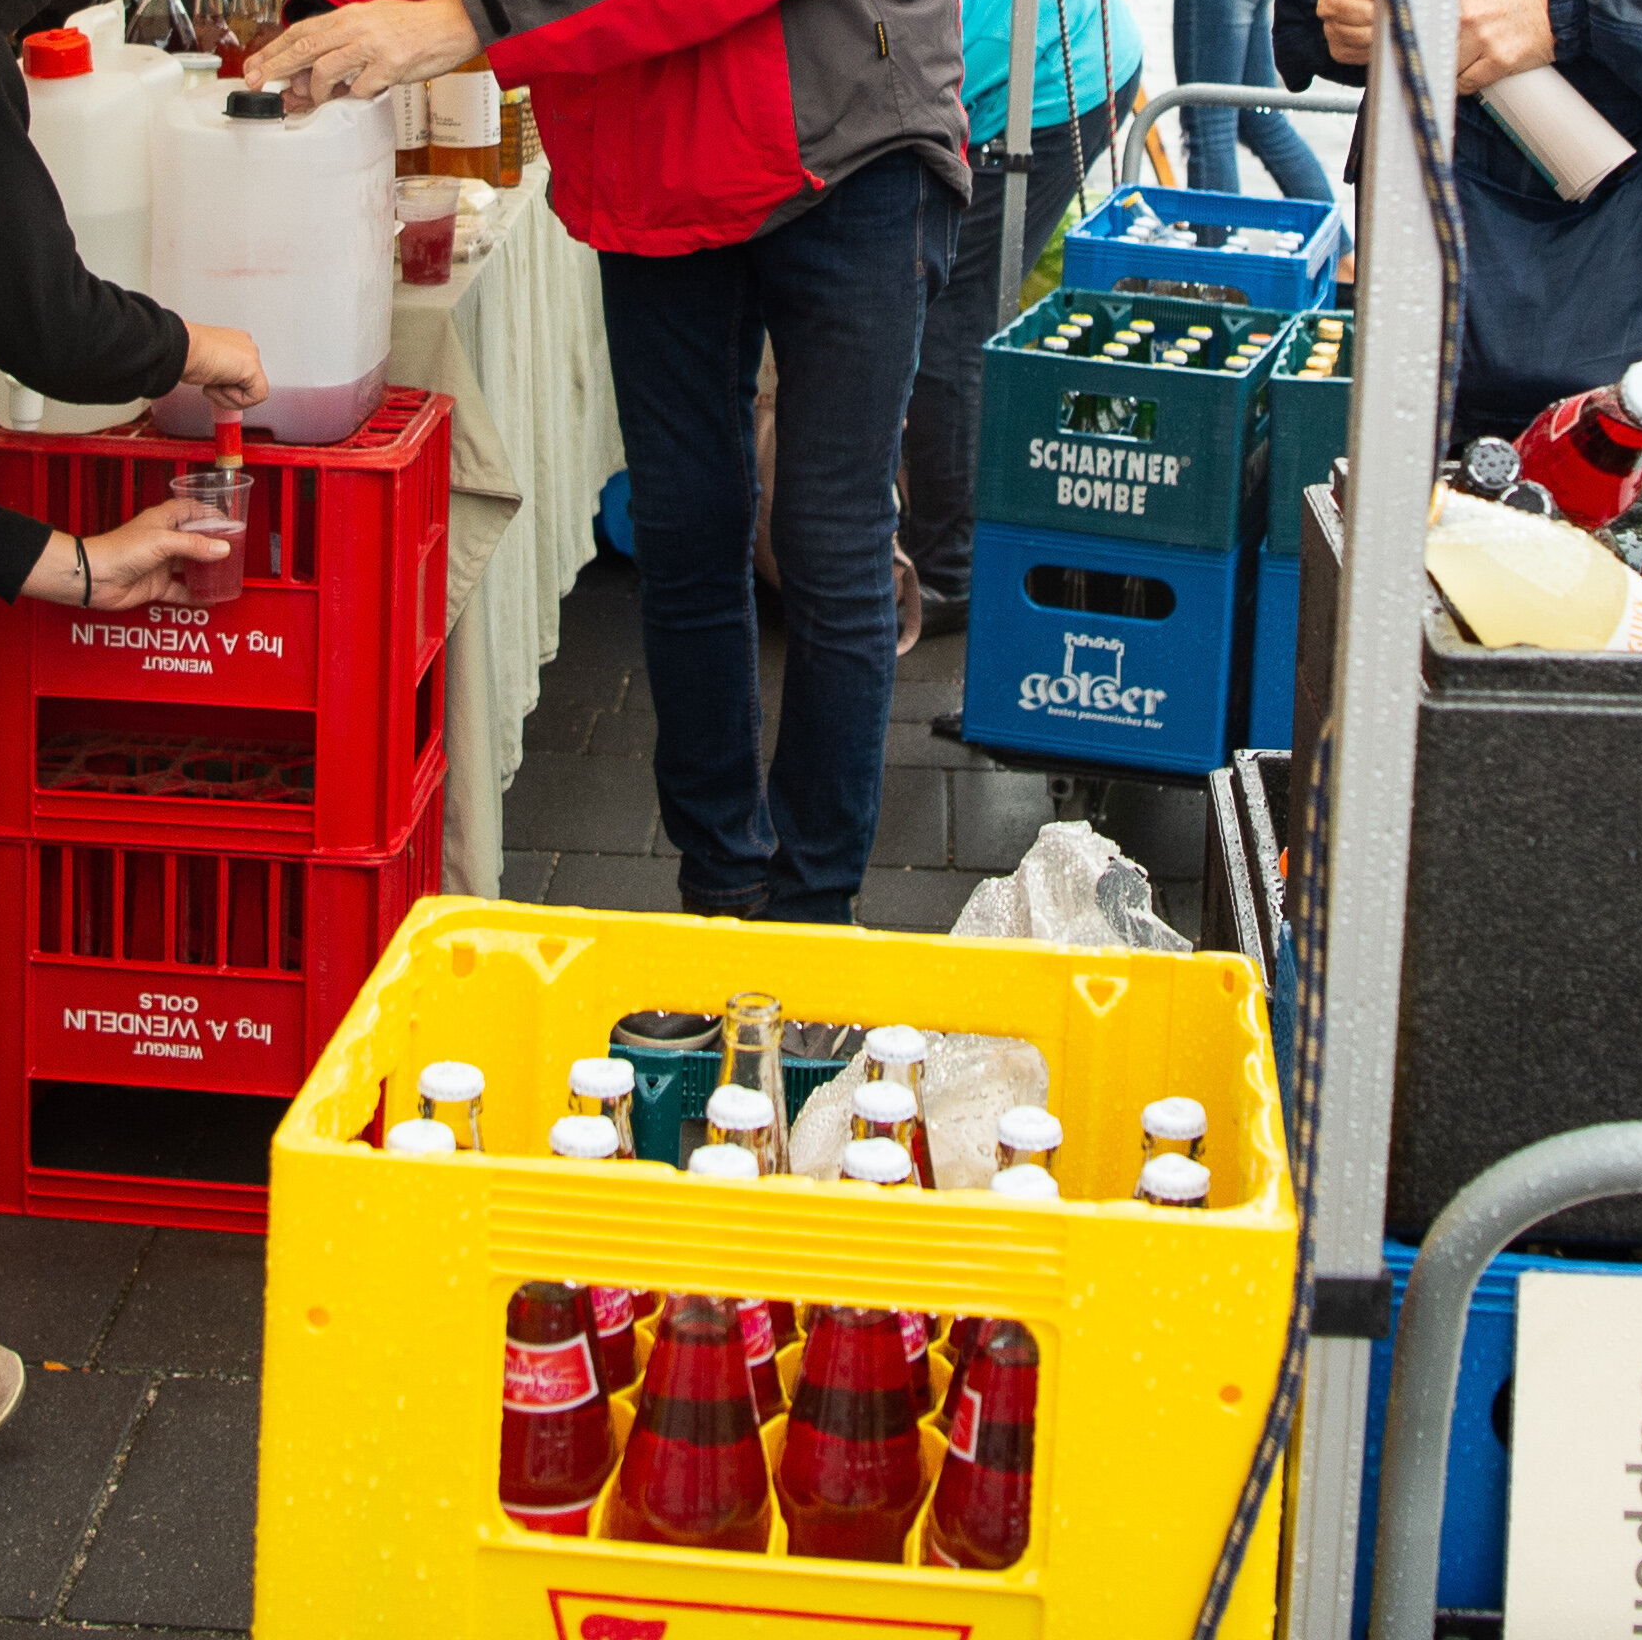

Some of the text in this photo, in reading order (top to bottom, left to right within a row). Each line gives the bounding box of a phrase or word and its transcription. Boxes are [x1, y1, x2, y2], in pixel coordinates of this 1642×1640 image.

[1030, 438, 1180, 486] SCHARTNER
[1057, 479, 1146, 514] BOMBE
[149, 606, 209, 625] GOLS
[71, 622, 283, 658] Ing. A. WENDELIN
[142, 656, 213, 675] WEINGUT
[139, 992, 199, 1012] GOLS
[63, 1008, 272, 1045] Ing. A. WENDELIN
[133, 1041, 203, 1060] WEINGUT
